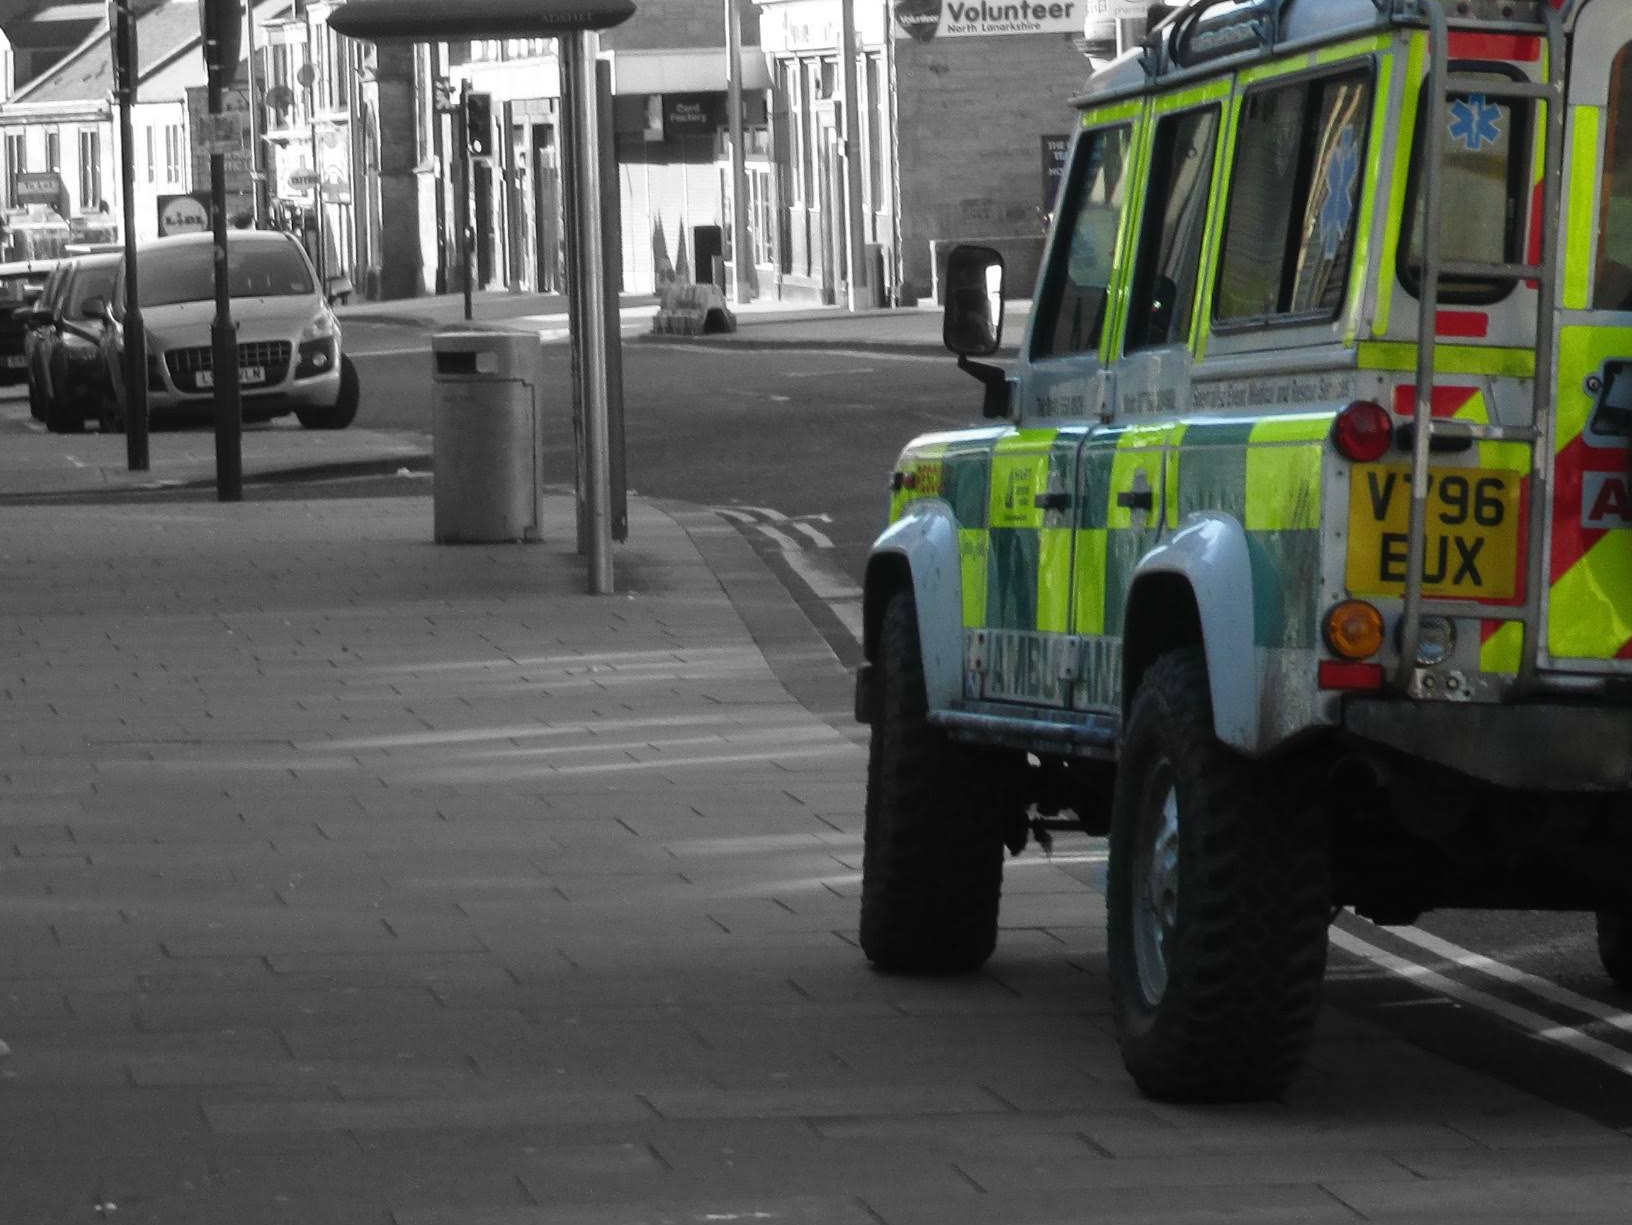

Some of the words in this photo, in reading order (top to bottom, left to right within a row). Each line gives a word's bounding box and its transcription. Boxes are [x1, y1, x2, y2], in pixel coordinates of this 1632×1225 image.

[947, 0, 1075, 23] Volunteer
[947, 23, 978, 33] North
[981, 22, 1041, 33] Lanarkshire
[1380, 532, 1484, 586] EUX
